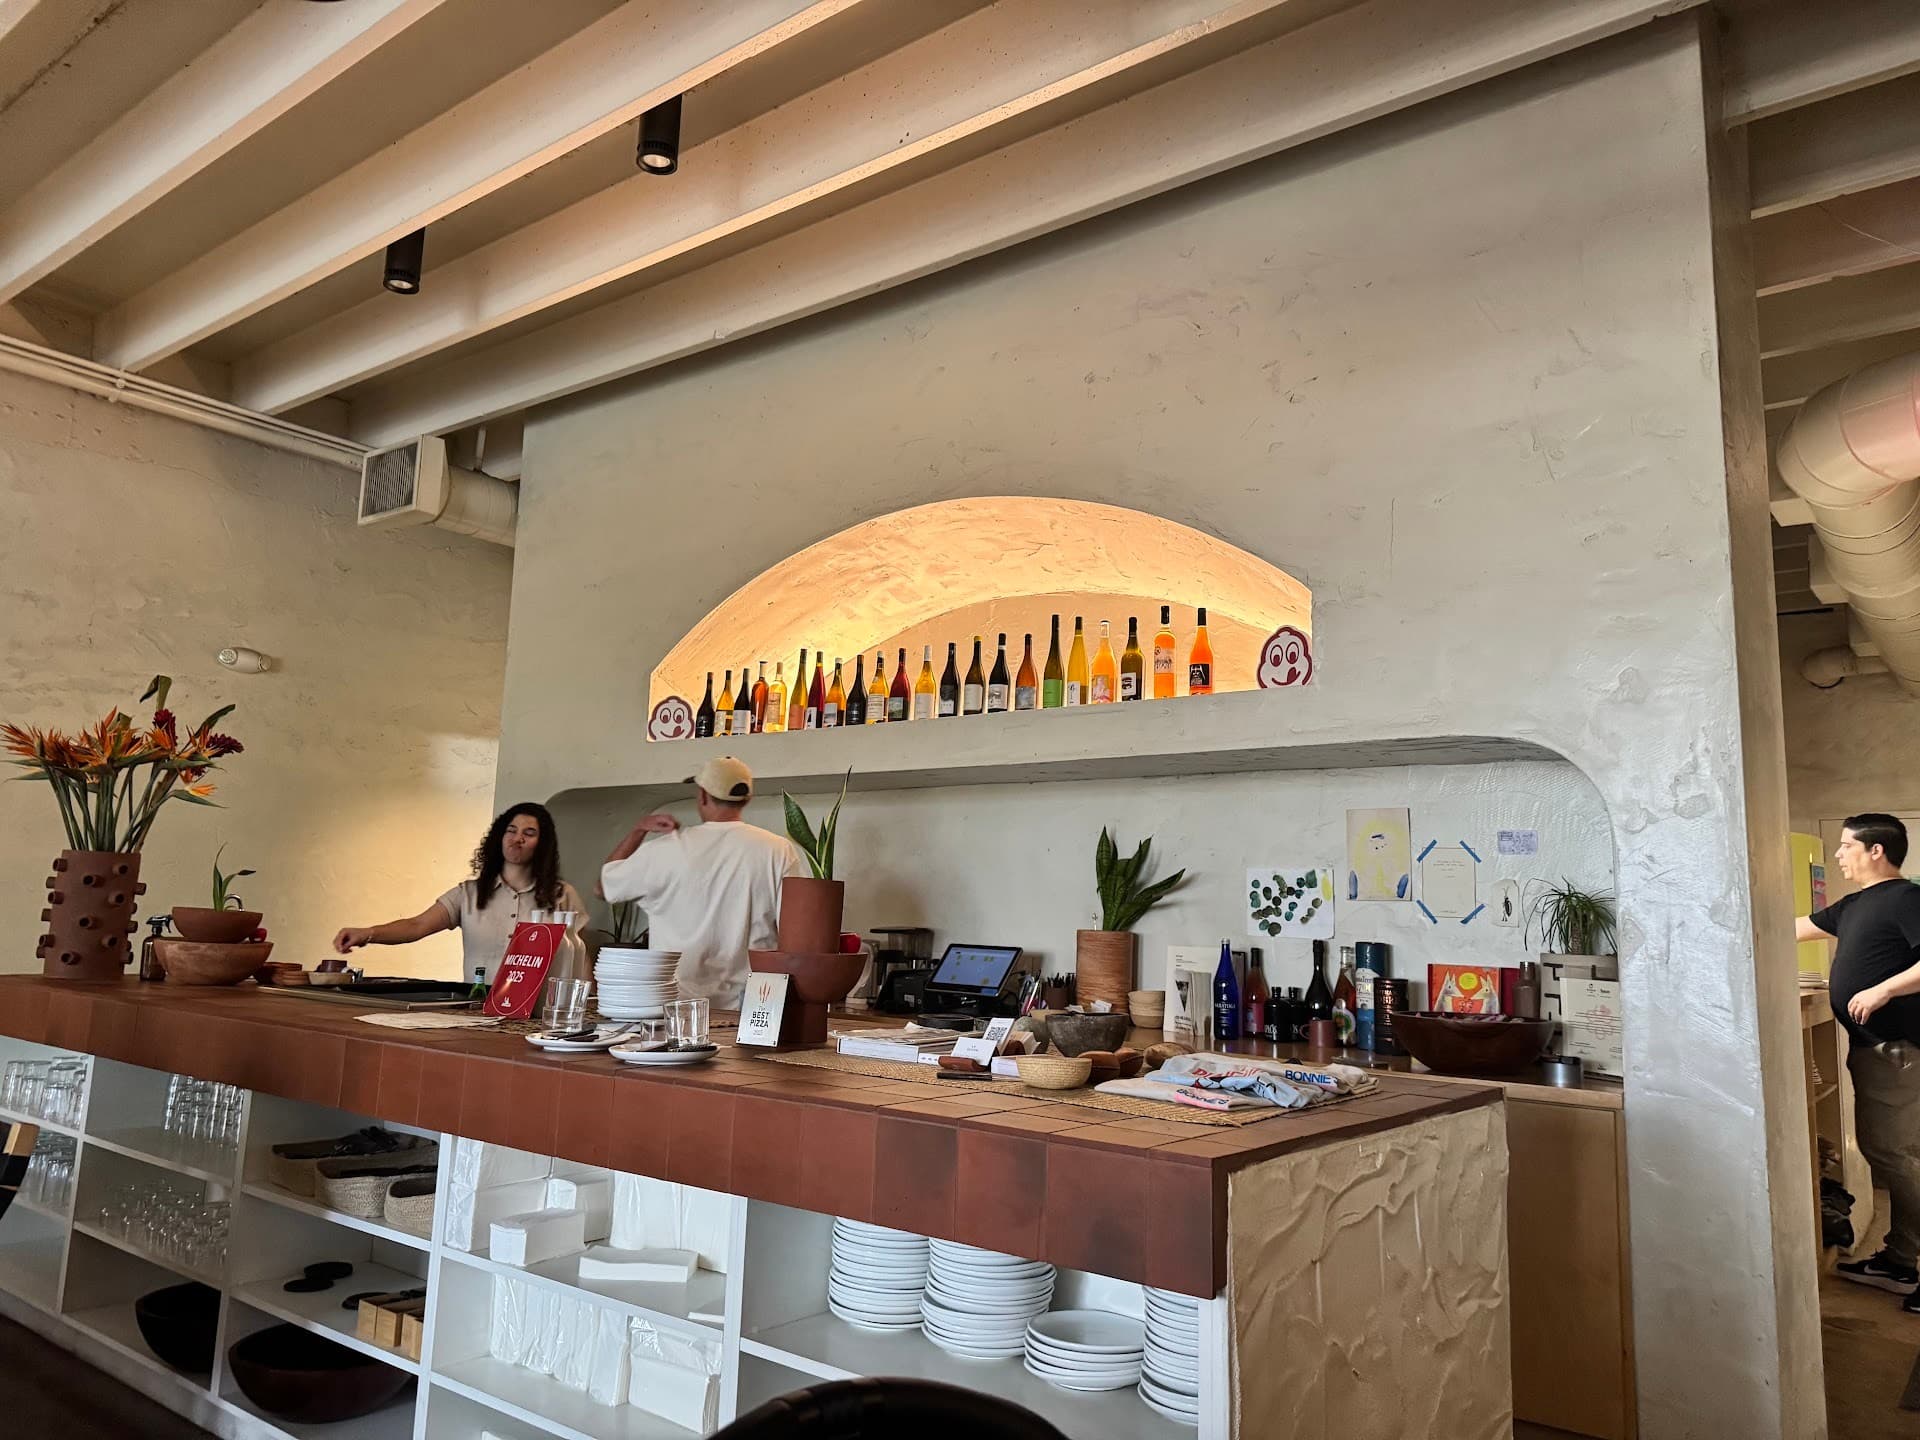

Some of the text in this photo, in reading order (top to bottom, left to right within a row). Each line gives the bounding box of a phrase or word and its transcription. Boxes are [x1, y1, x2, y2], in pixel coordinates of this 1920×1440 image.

[504, 954, 543, 968] MICHELIN
[507, 970, 525, 983] 2025
[752, 1011, 769, 1020] BEST
[749, 1019, 769, 1028] PIZZA
